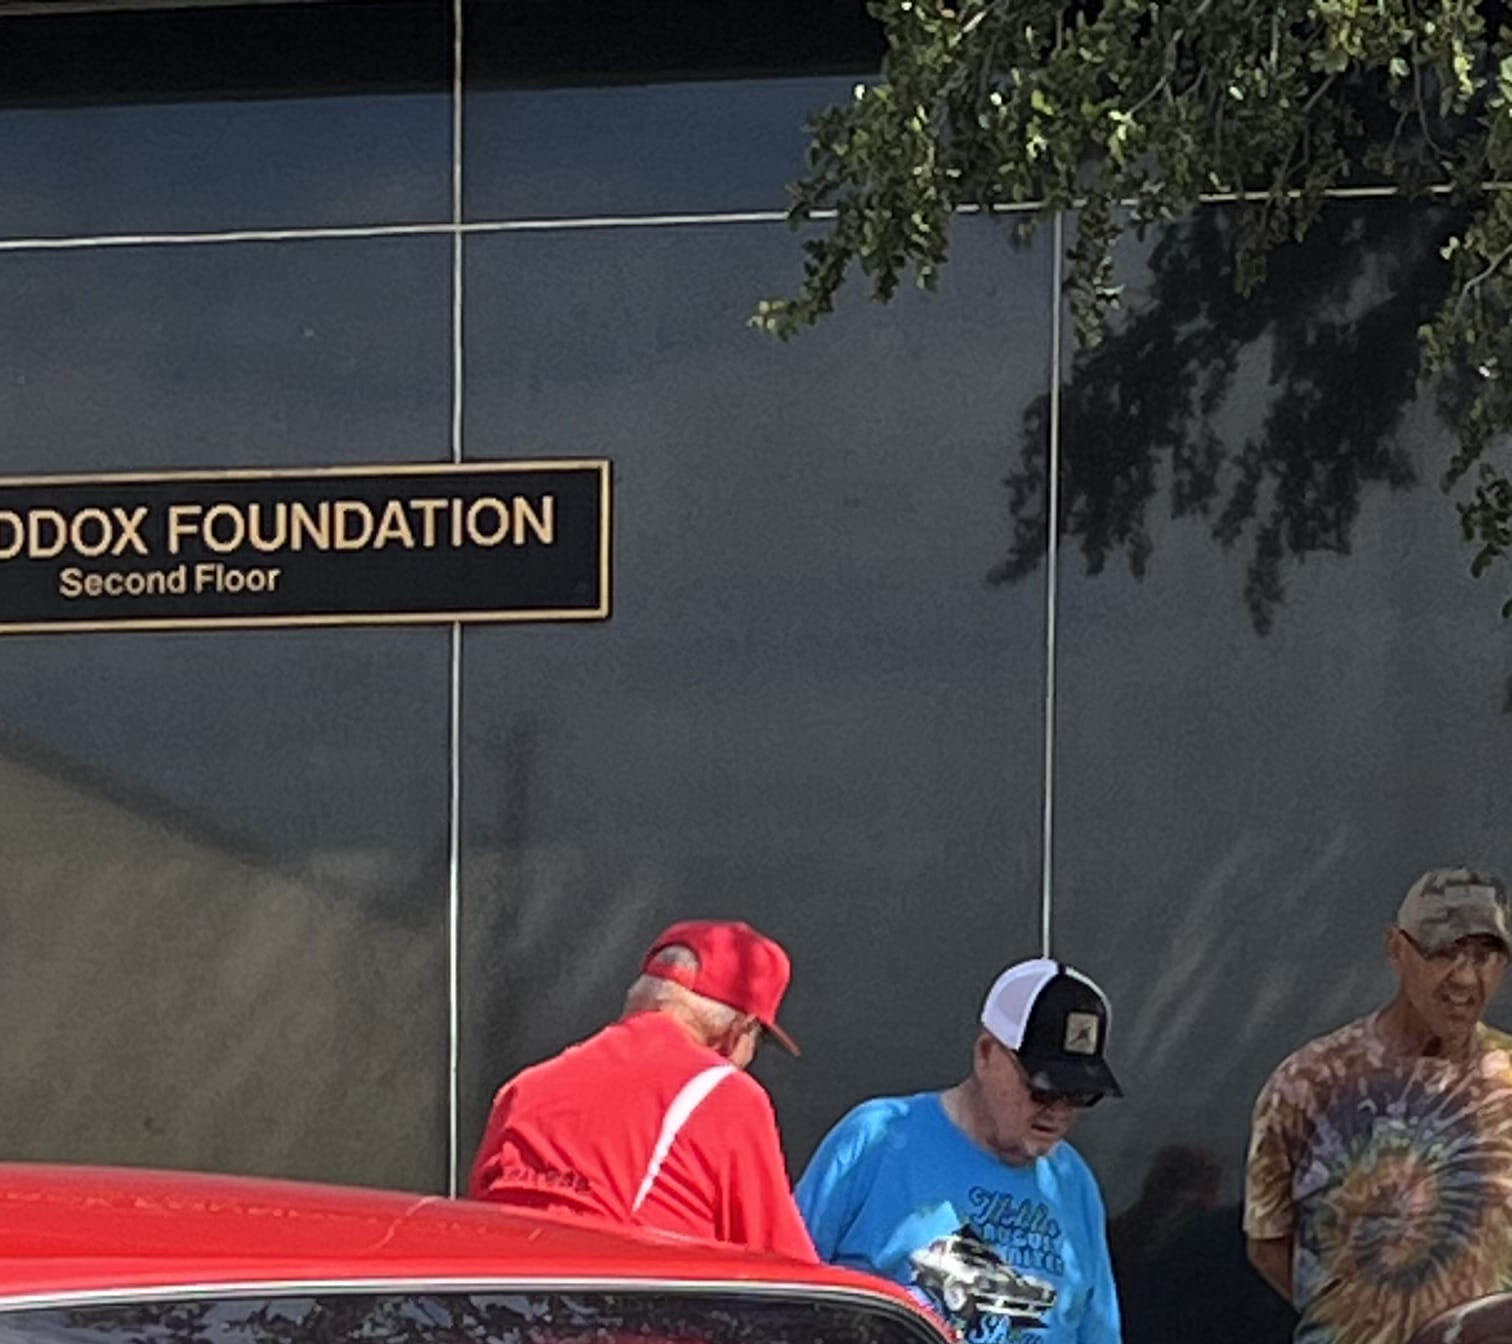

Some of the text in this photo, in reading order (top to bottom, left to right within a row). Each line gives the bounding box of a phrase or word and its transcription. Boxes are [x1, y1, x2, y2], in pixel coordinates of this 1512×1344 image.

[167, 495, 555, 555] FOUNDATION
[59, 563, 281, 598] Second Floor
